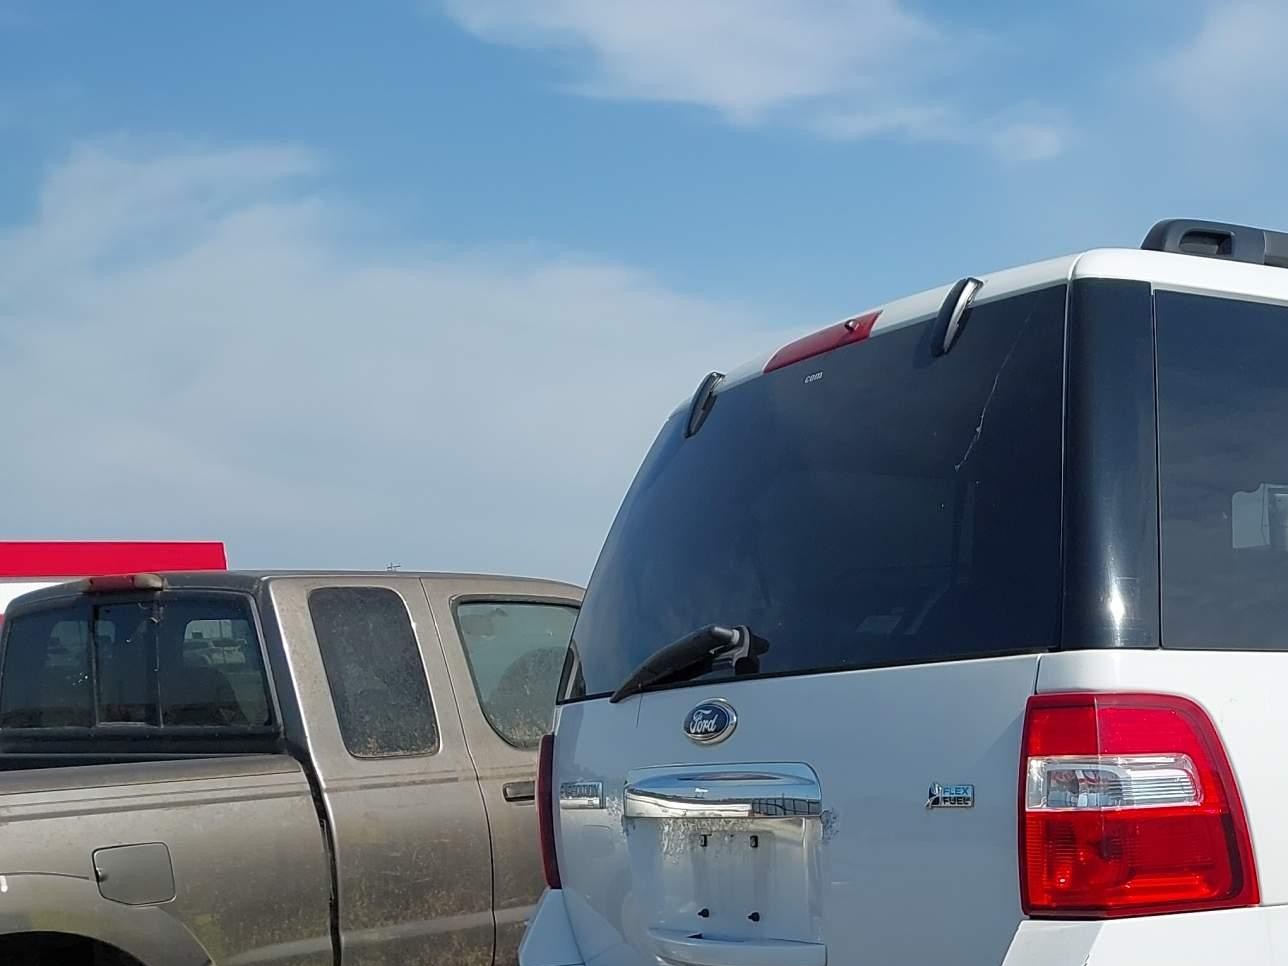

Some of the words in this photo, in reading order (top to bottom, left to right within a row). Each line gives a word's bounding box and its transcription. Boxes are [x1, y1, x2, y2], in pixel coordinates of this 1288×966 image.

[690, 709, 719, 734] Ford
[943, 787, 969, 796] FLEX
[943, 796, 971, 806] FUEL
